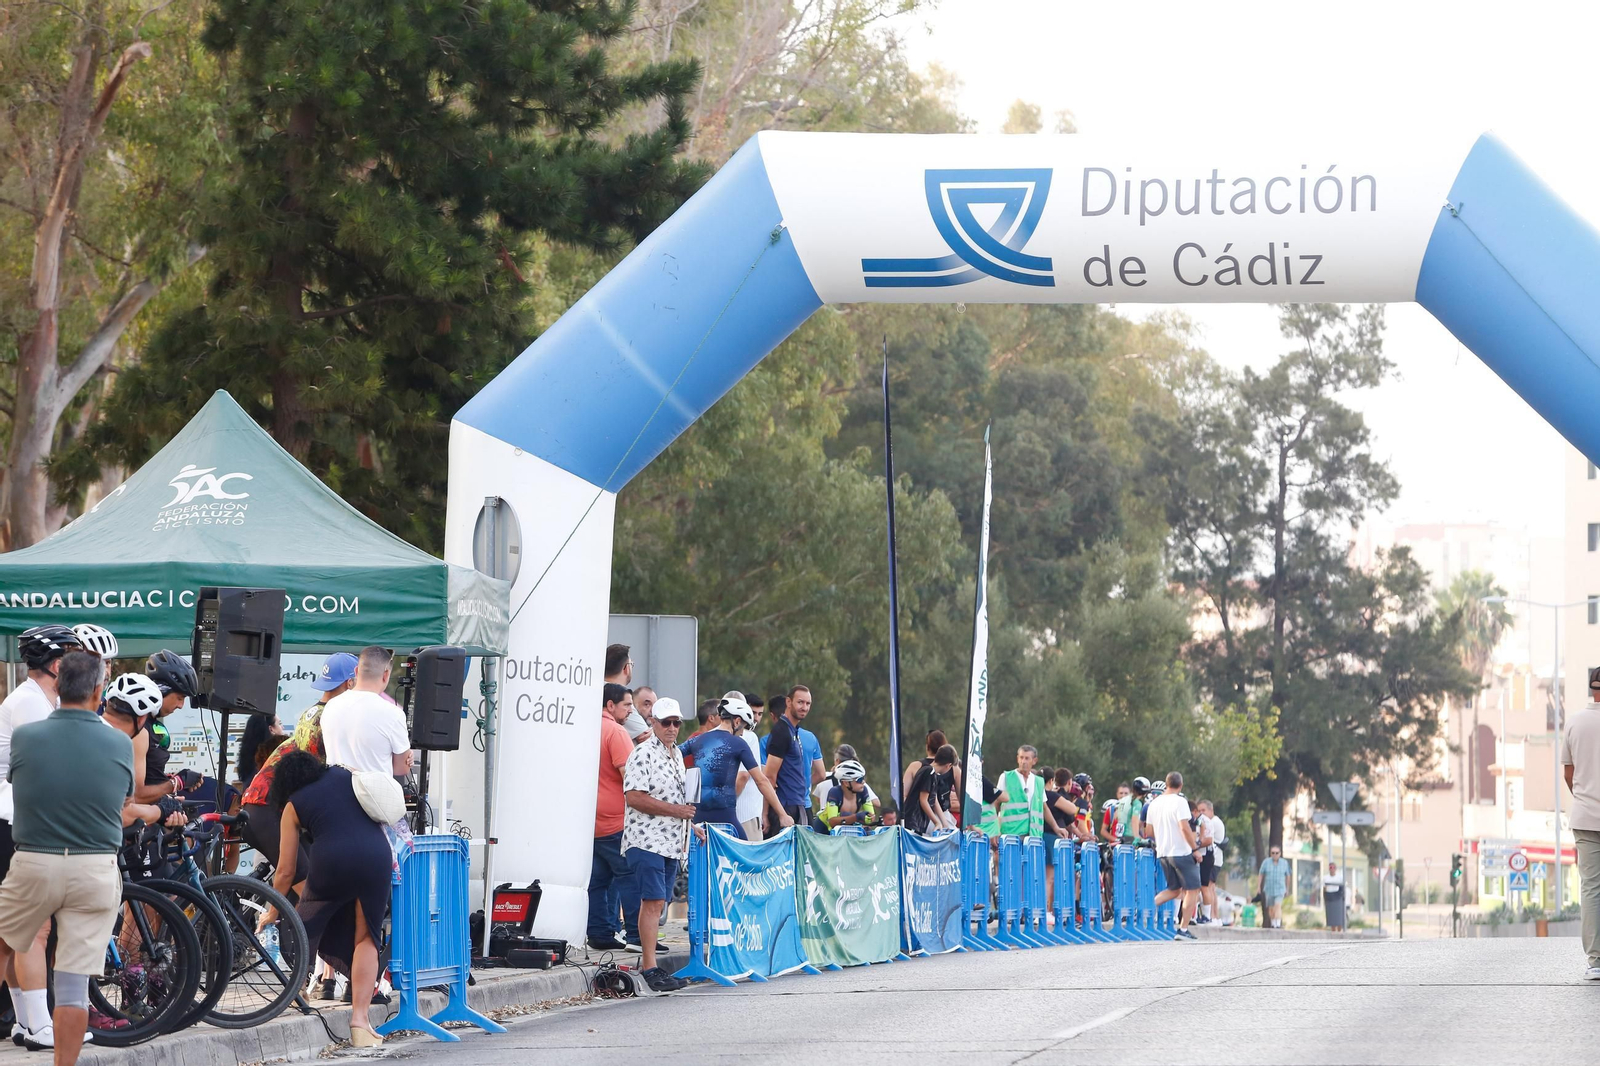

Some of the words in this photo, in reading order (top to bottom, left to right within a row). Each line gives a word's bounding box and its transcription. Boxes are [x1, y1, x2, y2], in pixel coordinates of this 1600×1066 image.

[1081, 164, 1377, 226] Diputación
[1083, 244, 1148, 287] de
[1173, 241, 1325, 287] Cádiz
[154, 510, 245, 525] ANDALUZA
[157, 502, 248, 518] FEDERACIÓN
[152, 518, 244, 531] CICLISMO
[505, 655, 592, 687] putación
[515, 693, 576, 726] Cádiz
[1513, 857, 1525, 866] 30
